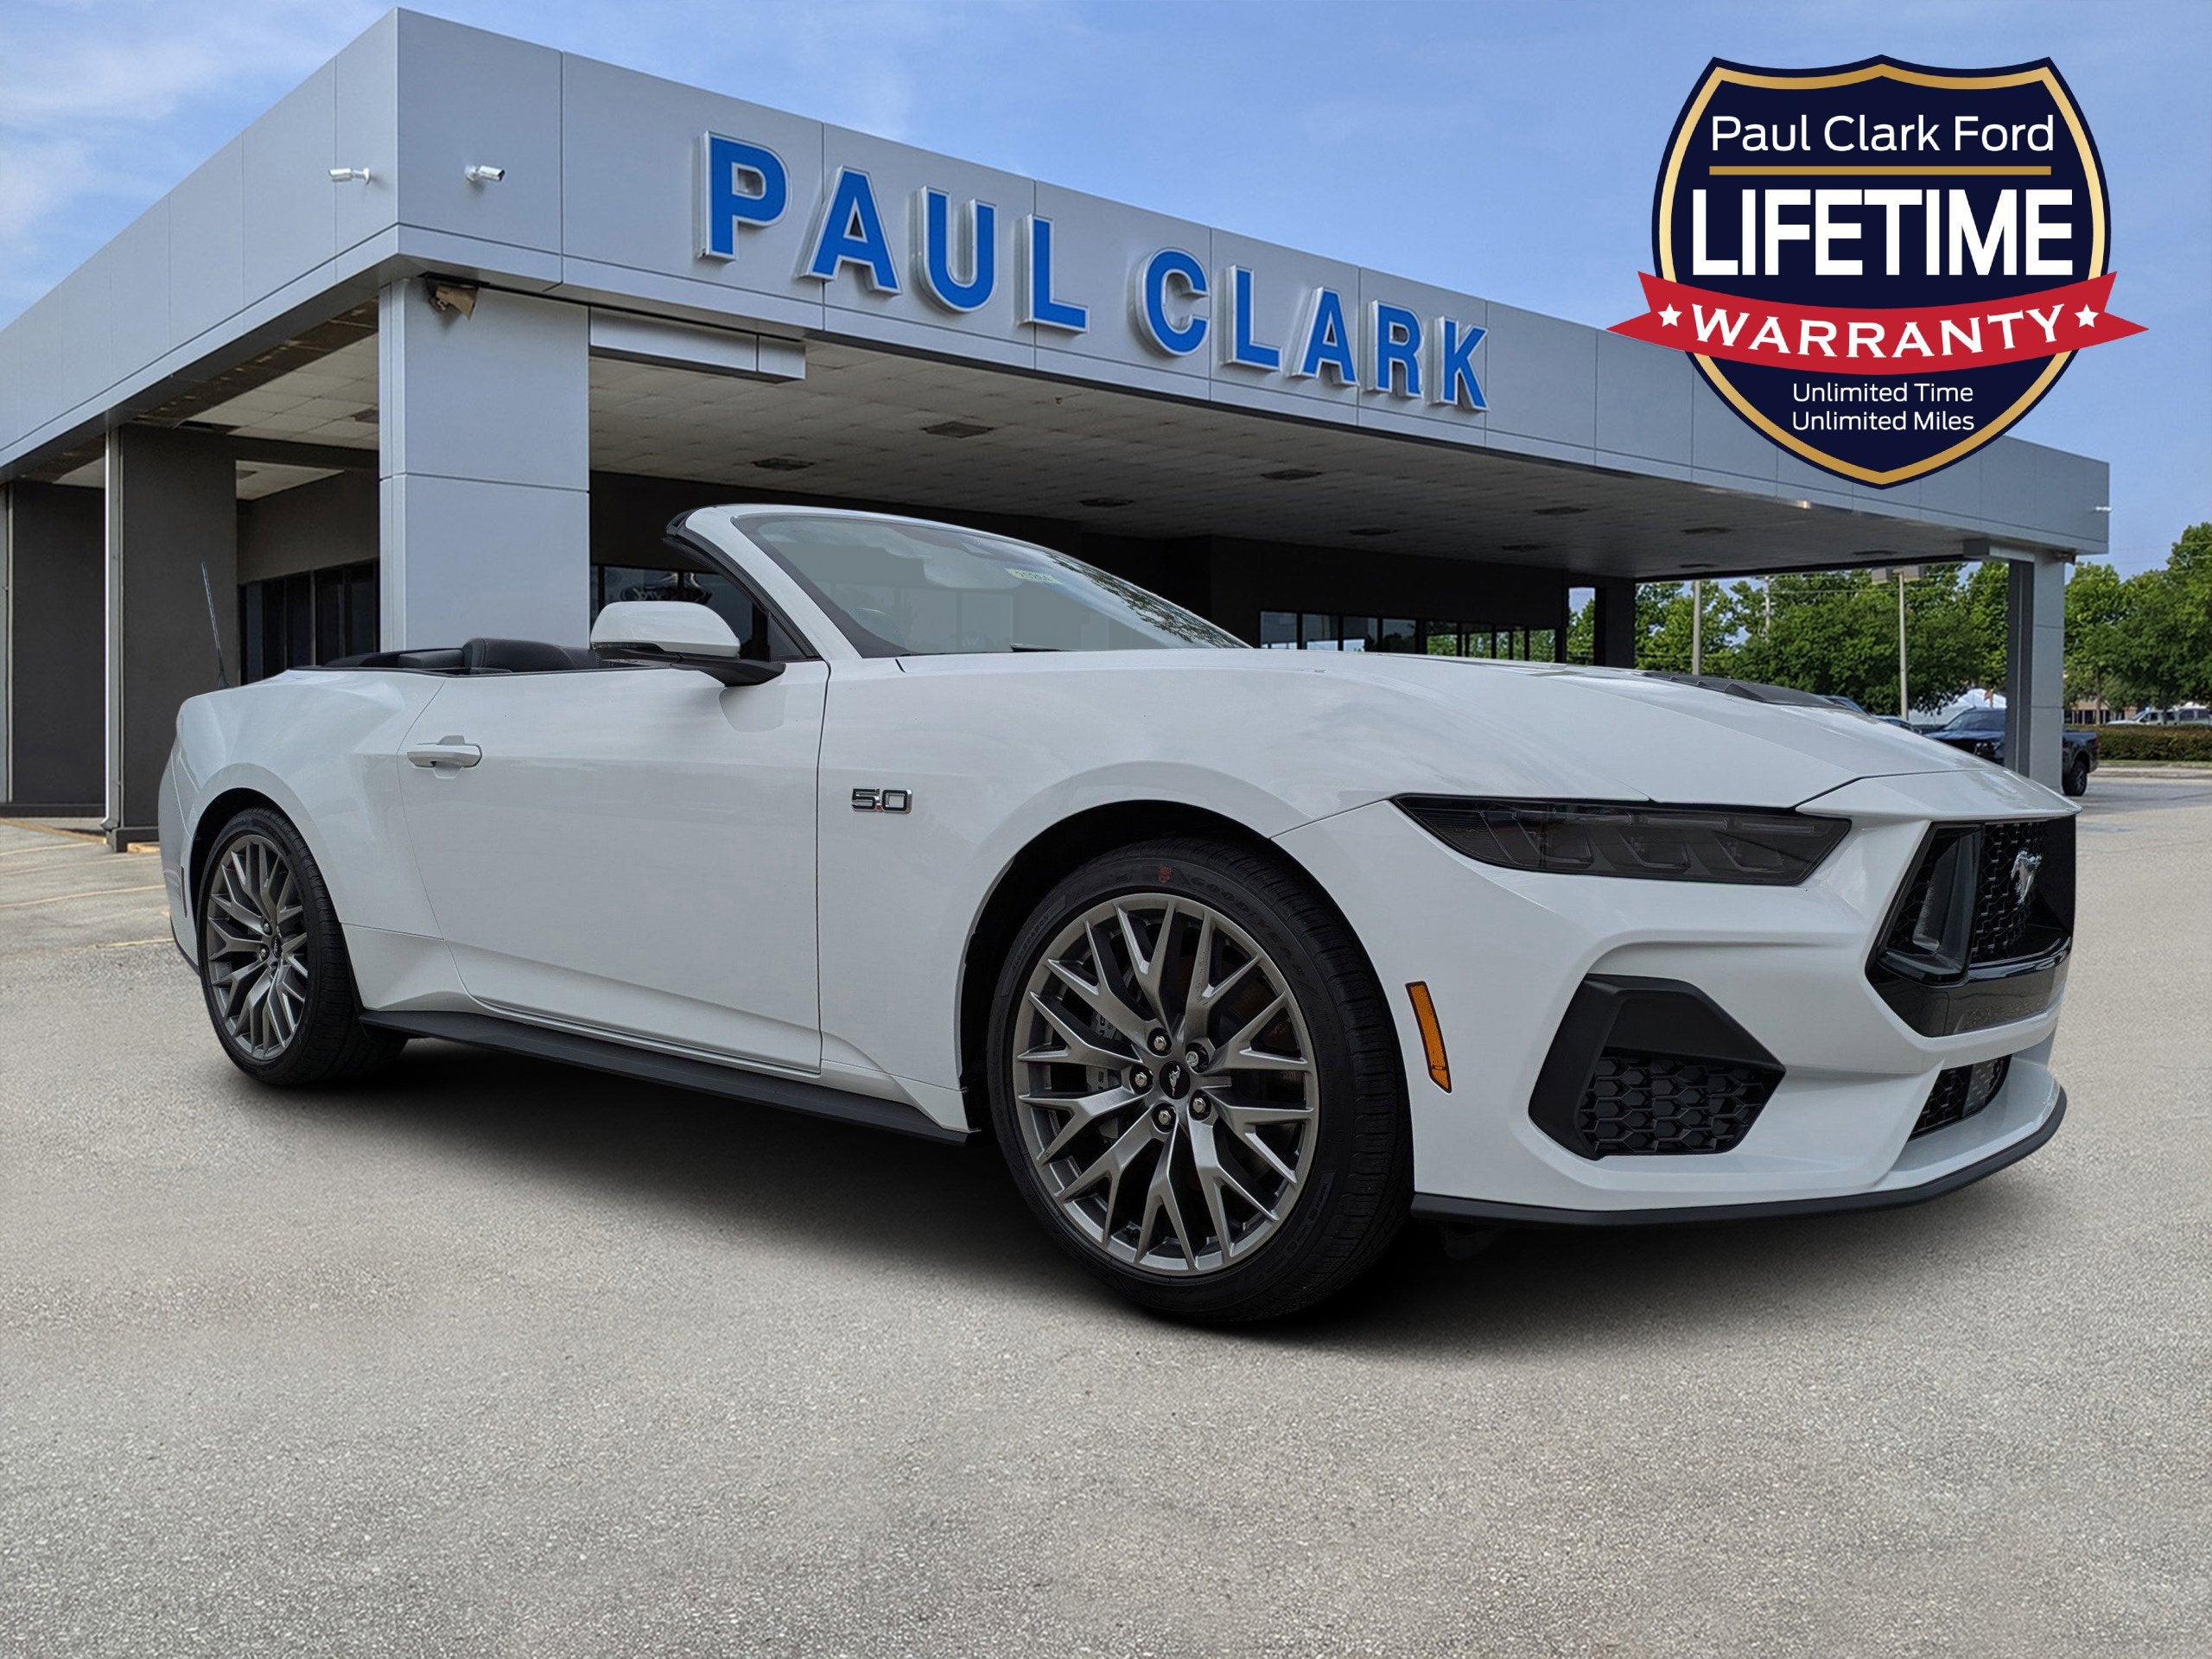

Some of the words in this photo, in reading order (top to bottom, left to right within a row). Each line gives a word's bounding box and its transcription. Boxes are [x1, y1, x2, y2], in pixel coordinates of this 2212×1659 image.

[703, 132, 1088, 333] PAUL
[1141, 248, 1490, 411] CLARK
[851, 787, 912, 814] 5.0
